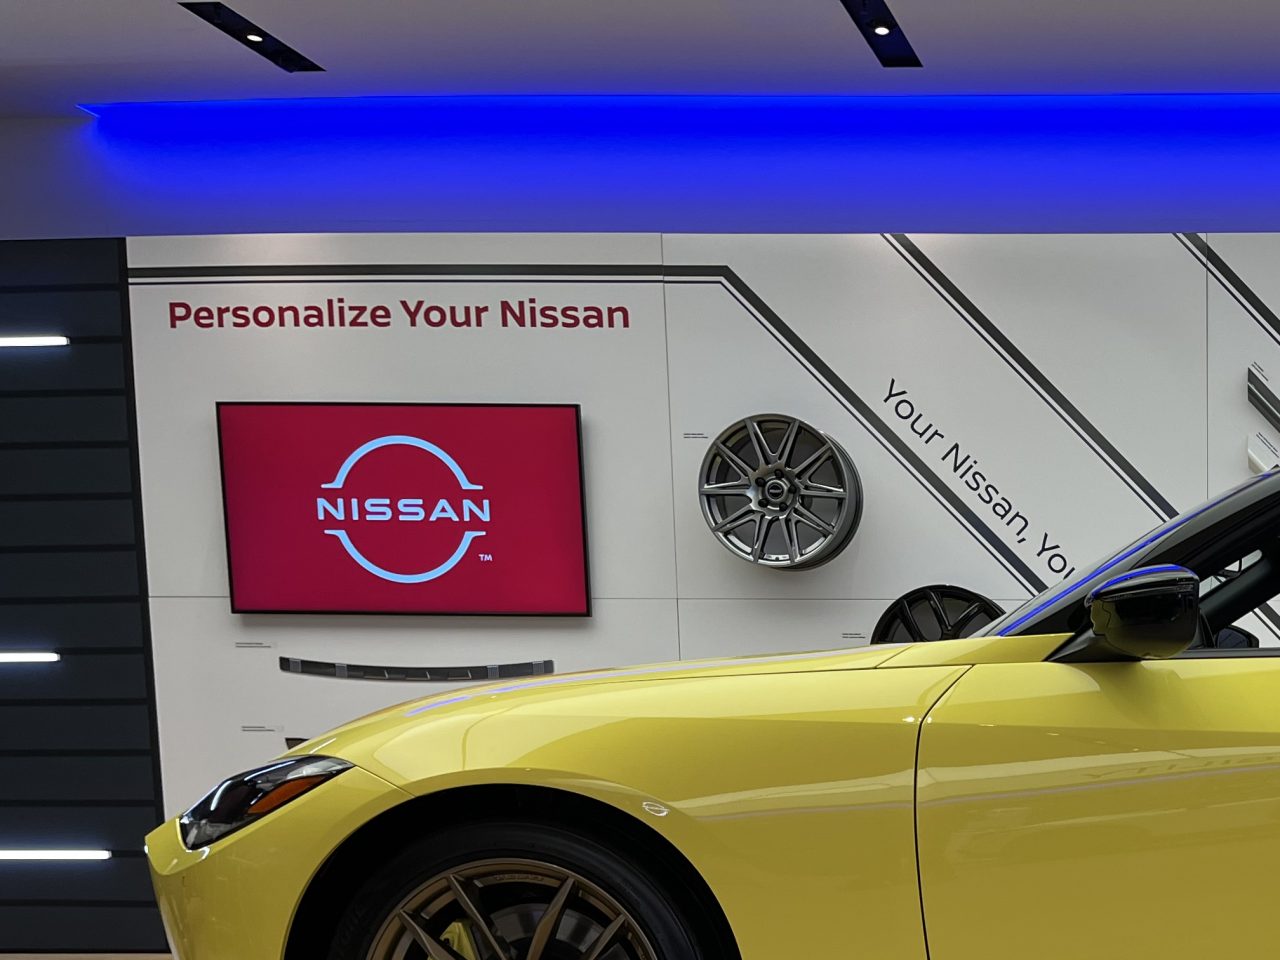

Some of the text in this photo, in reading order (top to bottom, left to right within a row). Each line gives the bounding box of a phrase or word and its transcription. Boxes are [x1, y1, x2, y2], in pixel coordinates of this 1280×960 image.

[169, 298, 630, 328] Personalize Your Nissan
[883, 378, 945, 444] Your
[941, 442, 1029, 544] Nissan,
[316, 497, 490, 522] NISSAN
[478, 554, 493, 562] TM
